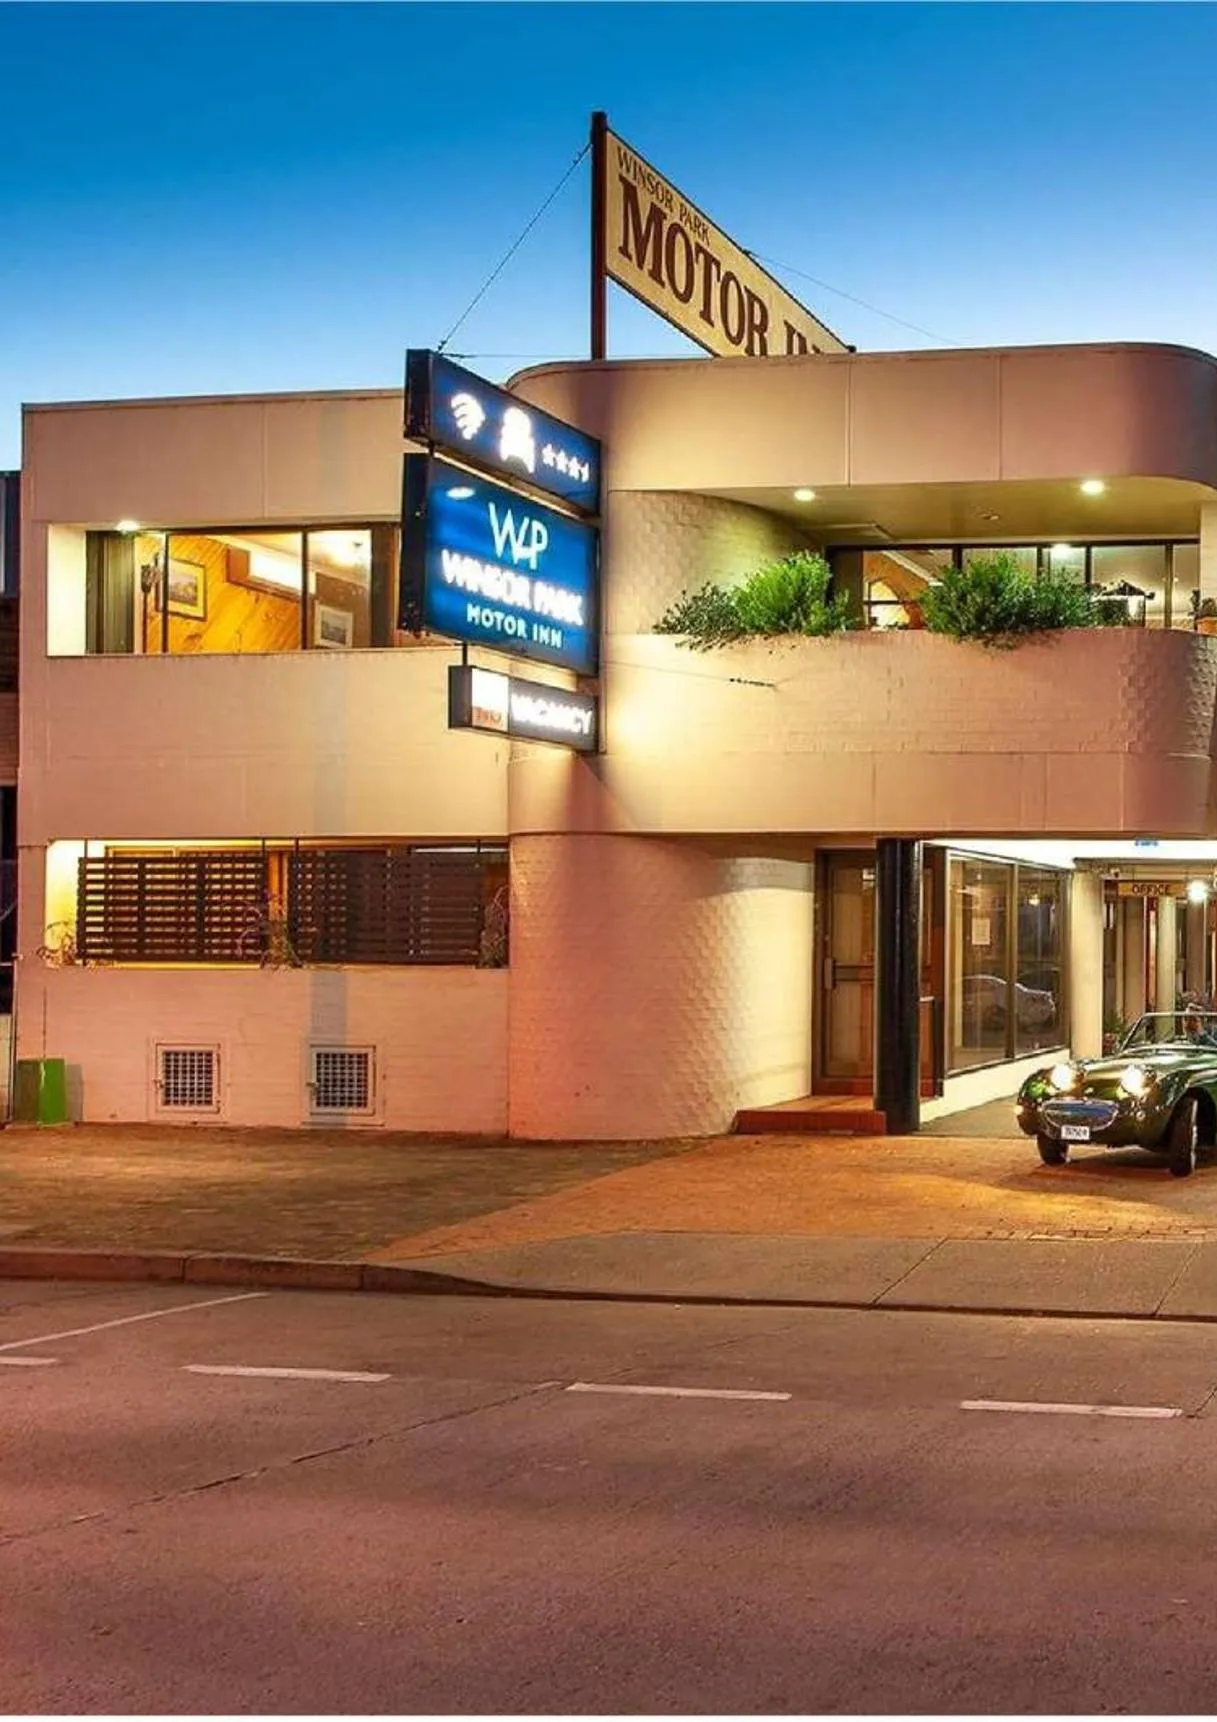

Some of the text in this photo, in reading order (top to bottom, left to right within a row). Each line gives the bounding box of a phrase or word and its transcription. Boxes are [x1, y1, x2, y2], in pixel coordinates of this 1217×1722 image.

[617, 146, 710, 246] WINSOR PARK
[618, 174, 769, 357] MOTOR
[466, 603, 563, 648] MOTOR INN
[1132, 884, 1170, 896] OFFICE
